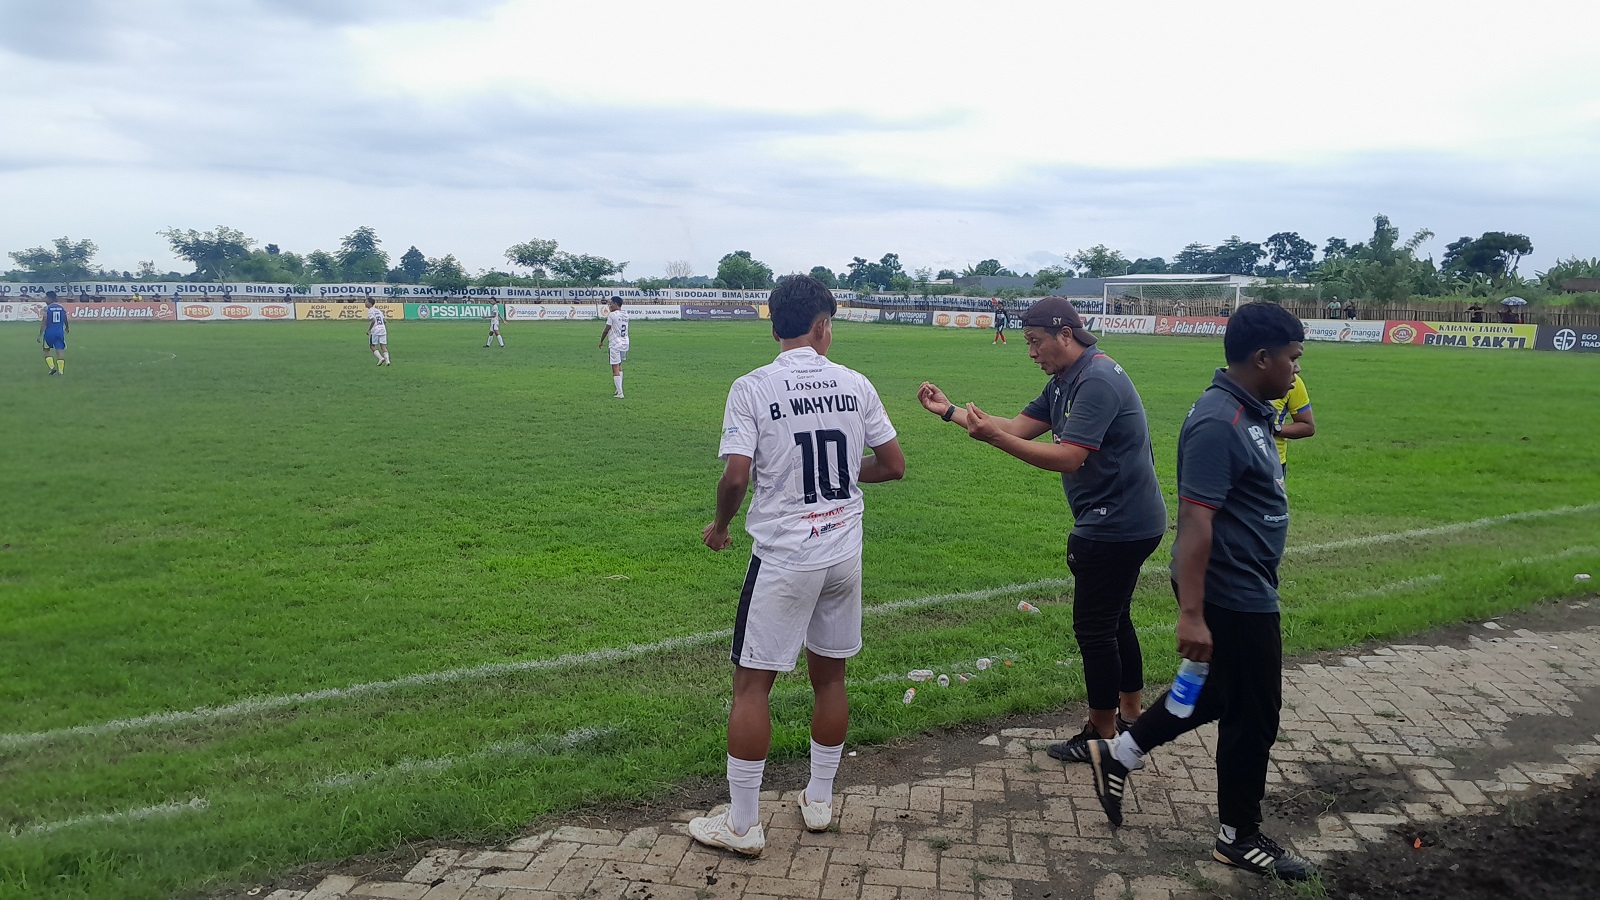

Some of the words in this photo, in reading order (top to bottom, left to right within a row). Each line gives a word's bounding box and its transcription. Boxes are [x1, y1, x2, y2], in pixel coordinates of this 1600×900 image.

[20, 286, 46, 294] ORA
[54, 285, 92, 293] SEPELE
[95, 285, 127, 293] BIMA
[131, 285, 167, 293] SAKTI
[176, 285, 238, 293] SIDODADI
[245, 285, 275, 294] BIMA
[320, 286, 376, 295] SIDODADI
[413, 287, 446, 296] SAKTI
[448, 287, 501, 296] SIDODADI
[507, 289, 532, 297] BIMA
[534, 289, 562, 297] SAKTI
[643, 290, 669, 298] SAKTI
[674, 291, 717, 299] SIDODADI
[722, 291, 743, 299] BIMA
[744, 291, 768, 300] SAKTI
[72, 306, 99, 318] Jelas
[101, 306, 127, 318] lebih
[128, 306, 154, 318] enak
[306, 310, 331, 319] ABC
[338, 310, 363, 319] ABC
[431, 305, 458, 317] PSSI
[458, 305, 491, 318] JATIM
[1052, 317, 1062, 325] SY
[1097, 317, 1147, 330] TRISAKTI
[1171, 321, 1194, 333] Jelas
[1194, 322, 1215, 334] lebih
[1309, 328, 1337, 337] mangga
[1351, 329, 1381, 338] mangga
[1581, 333, 1598, 341] EGO
[1423, 333, 1468, 348] BIMA
[1471, 335, 1527, 350] SAKTI
[784, 379, 838, 392] Lososa
[769, 402, 787, 421] B.
[789, 394, 859, 416] WAHYUDI
[793, 428, 852, 505] 10
